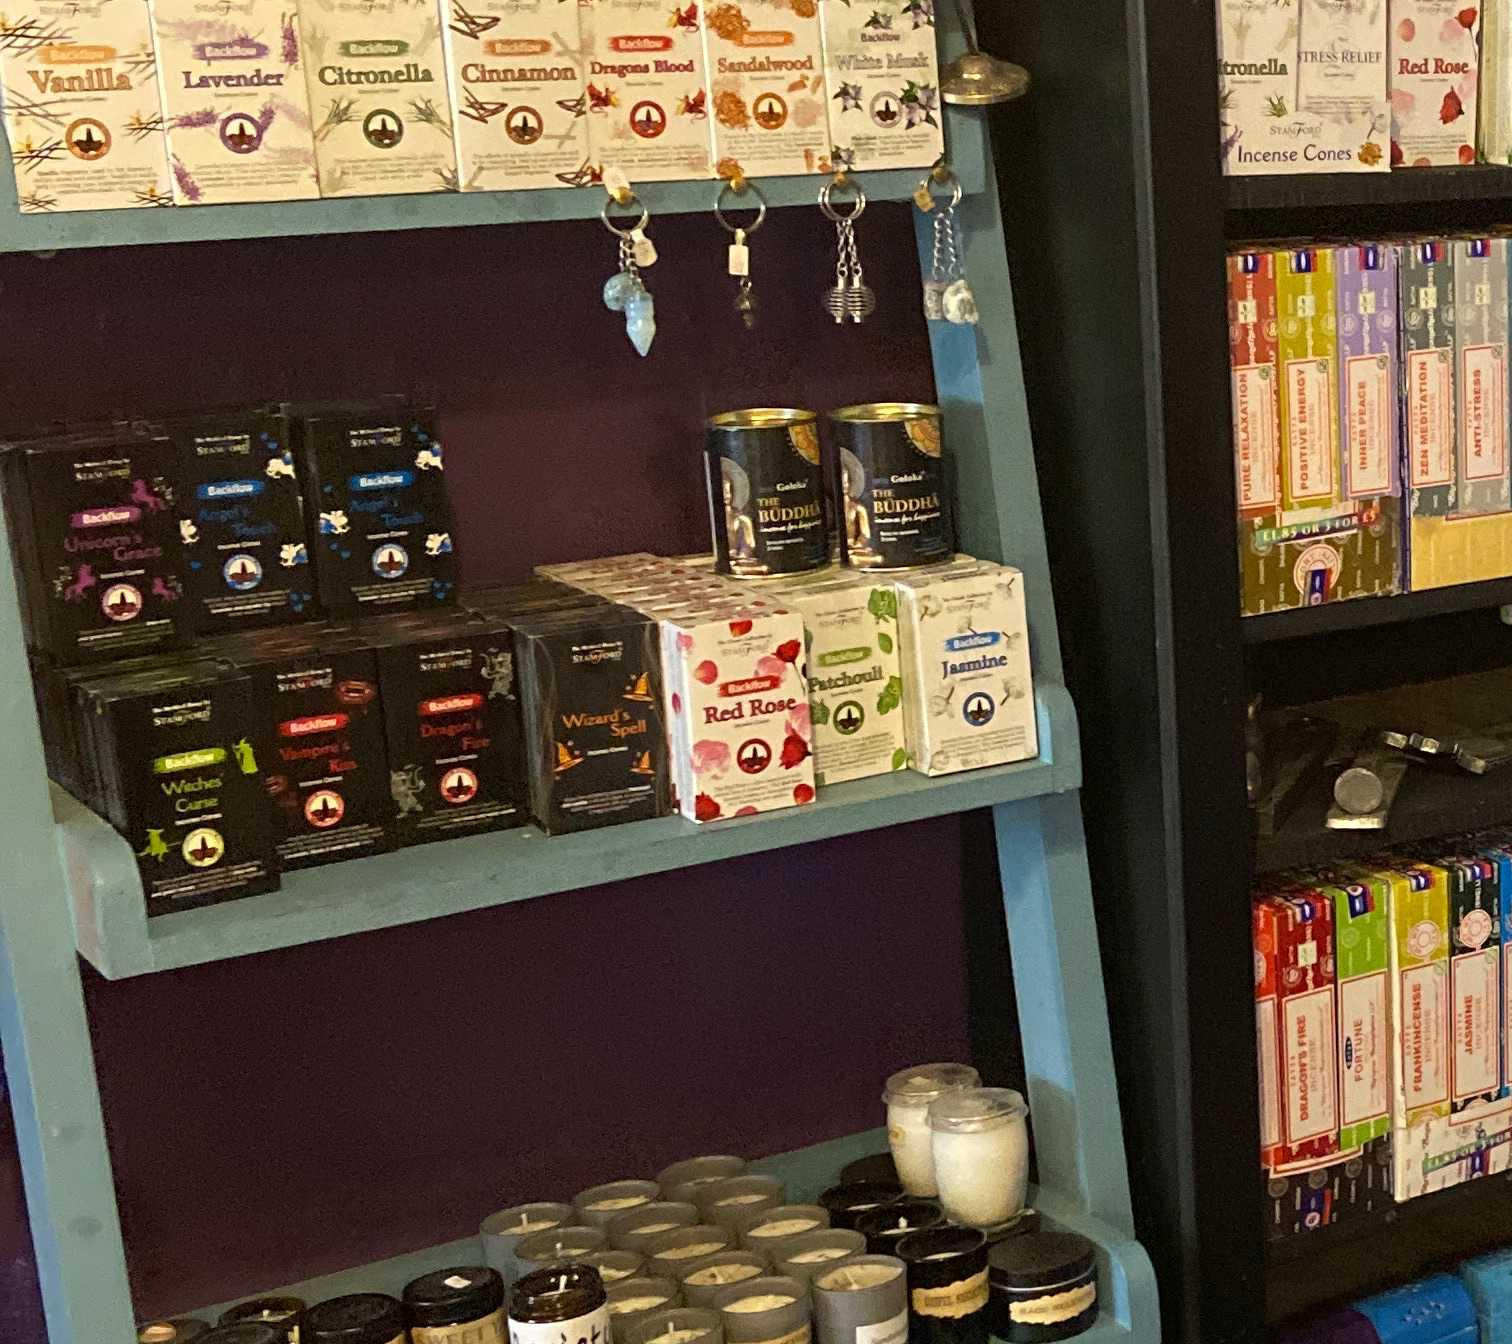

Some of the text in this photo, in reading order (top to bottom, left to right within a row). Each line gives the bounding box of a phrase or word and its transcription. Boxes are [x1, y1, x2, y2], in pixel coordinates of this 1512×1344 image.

[717, 56, 814, 74] Sandalwood
[1341, 51, 1381, 64] RELIEF
[1398, 58, 1469, 75] Red Rose
[183, 69, 284, 88] Lavender
[319, 64, 434, 86] Citronella
[462, 64, 577, 82] Cinnamon
[591, 60, 694, 77] Dragons Blood
[28, 68, 132, 94] Vanilla
[1237, 144, 1352, 163] Incense Cones
[1419, 361, 1428, 445] MEDITATION
[1297, 368, 1308, 490] POSITIVE ENERGY
[1358, 381, 1367, 470] INNER PEACE
[1239, 373, 1251, 501] PURE RELAXATION
[360, 474, 403, 485] Backflow
[757, 497, 780, 507] THE
[872, 488, 895, 499] THE
[1302, 524, 1320, 534] OR
[941, 653, 1007, 678] Jasmine
[809, 667, 884, 692] Patchouli
[563, 709, 631, 729] Wizard's
[704, 696, 796, 724] Red Rose
[290, 716, 337, 730] Backflow
[611, 720, 647, 738] Spell
[1464, 994, 1473, 1055] JASMINE
[1412, 983, 1423, 1092] FRANKINCENSE
[1353, 1018, 1364, 1082] FORTUNE
[1296, 1015, 1309, 1121] DRAGON'S FIRE
